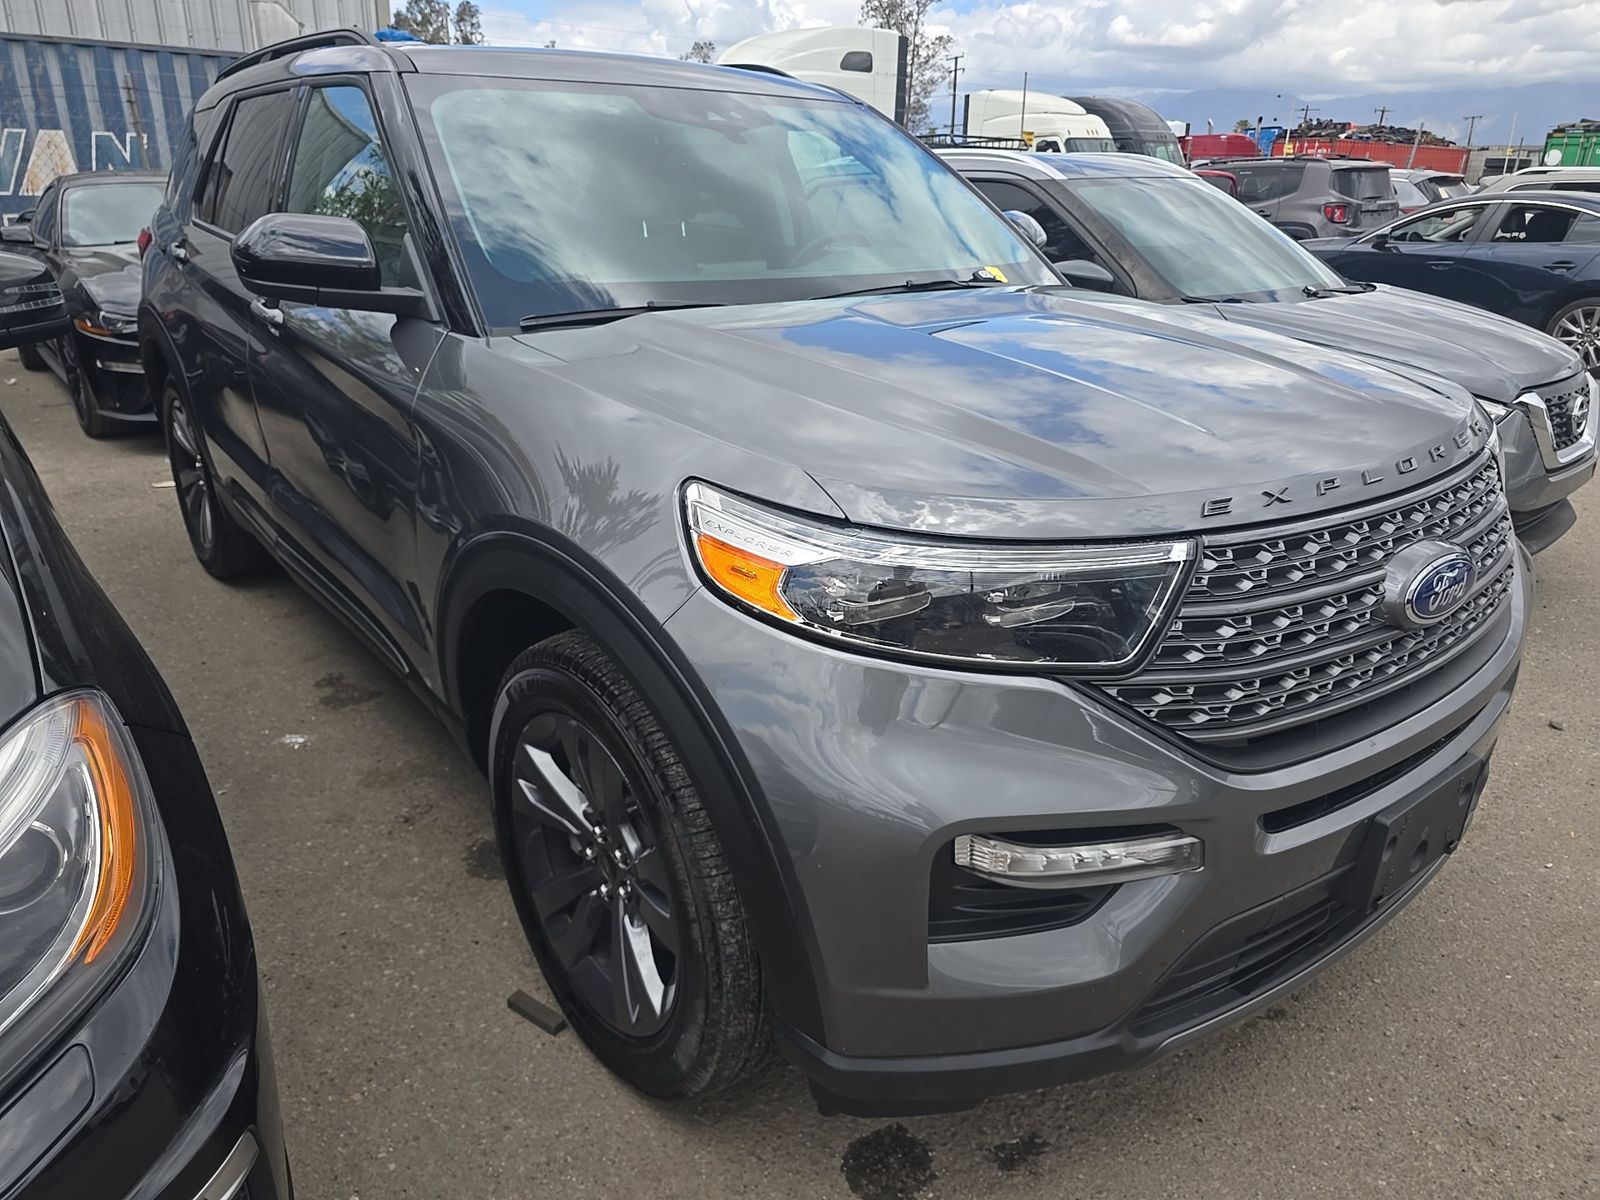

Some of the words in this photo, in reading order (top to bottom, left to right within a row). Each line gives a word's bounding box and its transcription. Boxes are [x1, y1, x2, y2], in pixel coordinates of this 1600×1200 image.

[1200, 419, 1484, 518] EXPLORER
[705, 519, 793, 557] EXPLORER
[1429, 567, 1468, 612] Ford
